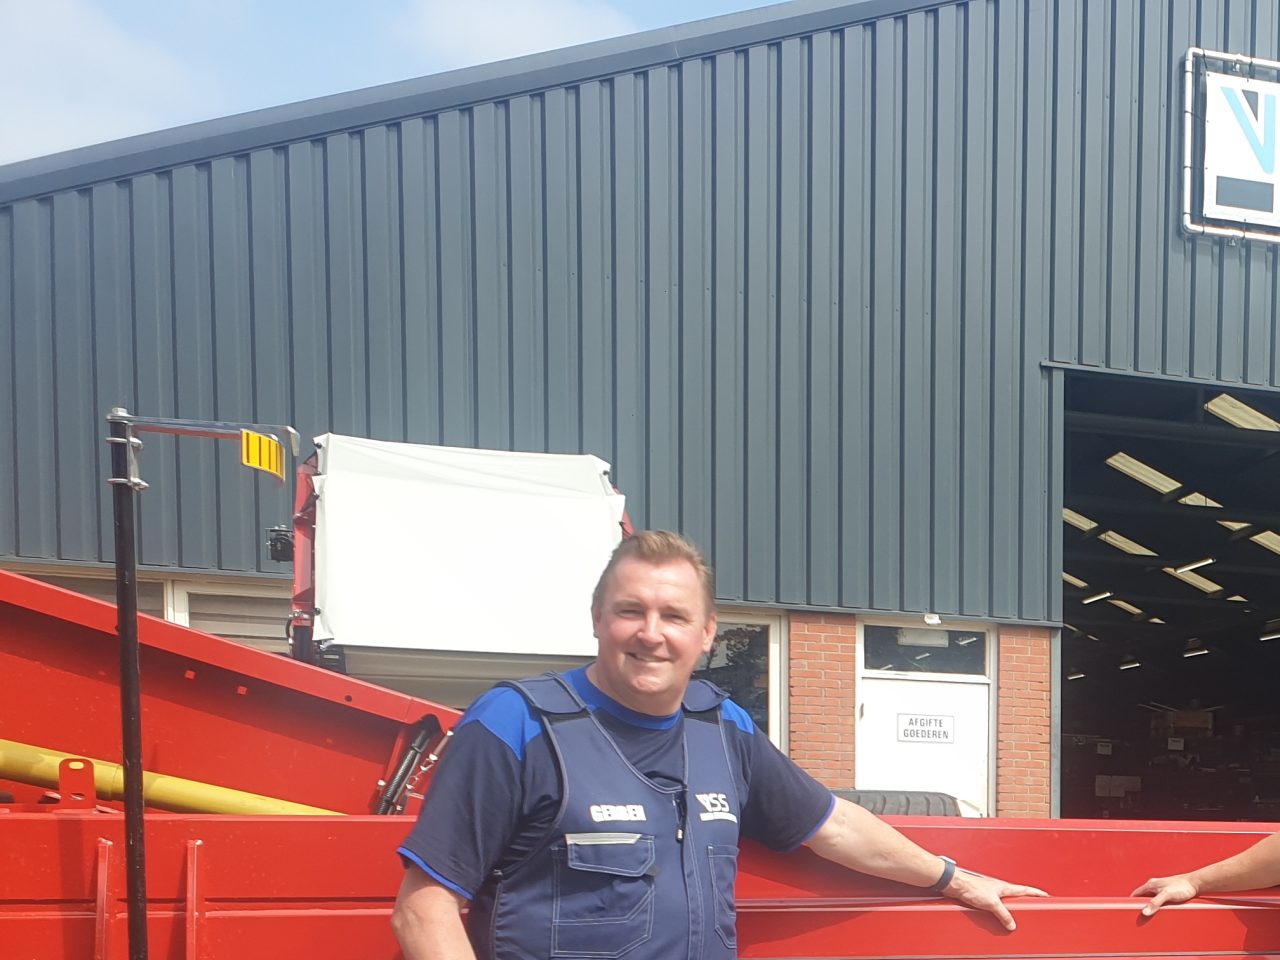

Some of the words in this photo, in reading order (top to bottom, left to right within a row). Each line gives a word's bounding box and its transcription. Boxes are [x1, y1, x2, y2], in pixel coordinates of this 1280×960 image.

[908, 718, 944, 728] AFGIFTE
[903, 729, 949, 739] GOEDEREN
[695, 793, 730, 812] VSS
